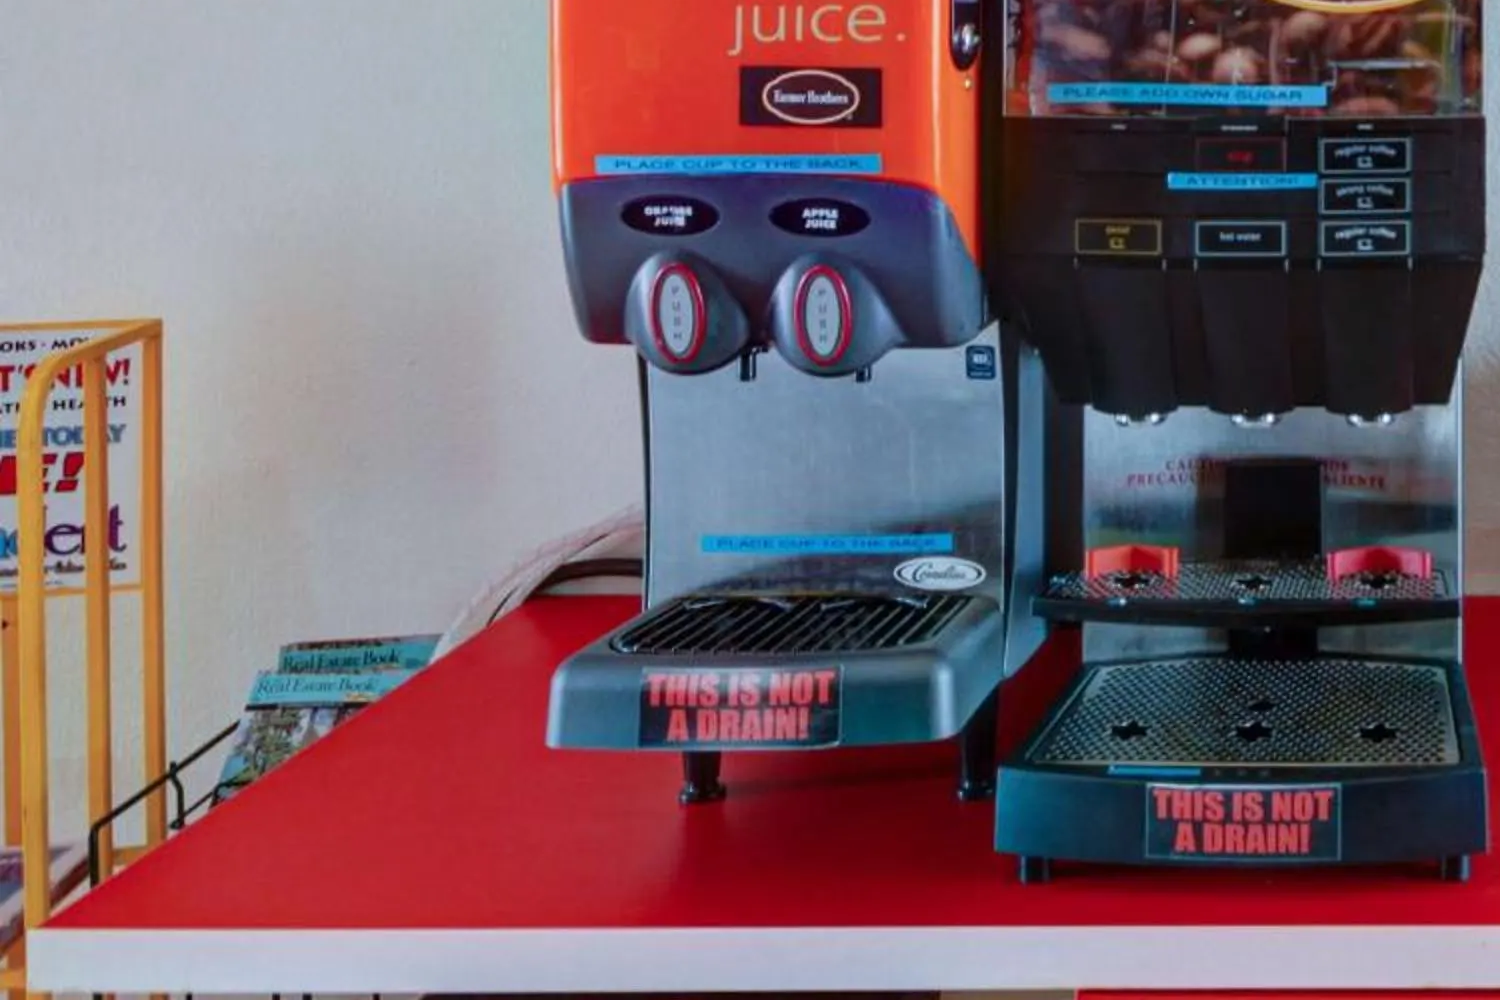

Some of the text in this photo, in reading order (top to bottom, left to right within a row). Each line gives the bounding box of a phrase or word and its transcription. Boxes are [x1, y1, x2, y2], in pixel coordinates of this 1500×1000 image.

[1063, 85, 1304, 102] PLEASE ADD OWN SUGAR
[614, 158, 862, 170] PLACE CUP TO THE BACK
[802, 208, 839, 220] APPLE
[805, 219, 837, 230] JUICE
[364, 648, 399, 665] Book
[646, 671, 836, 706] THIS IS NOT
[667, 707, 810, 742] A DRAIN!
[1152, 788, 1333, 822] THIS IS NOT
[1174, 824, 1310, 854] A DRAIN!
